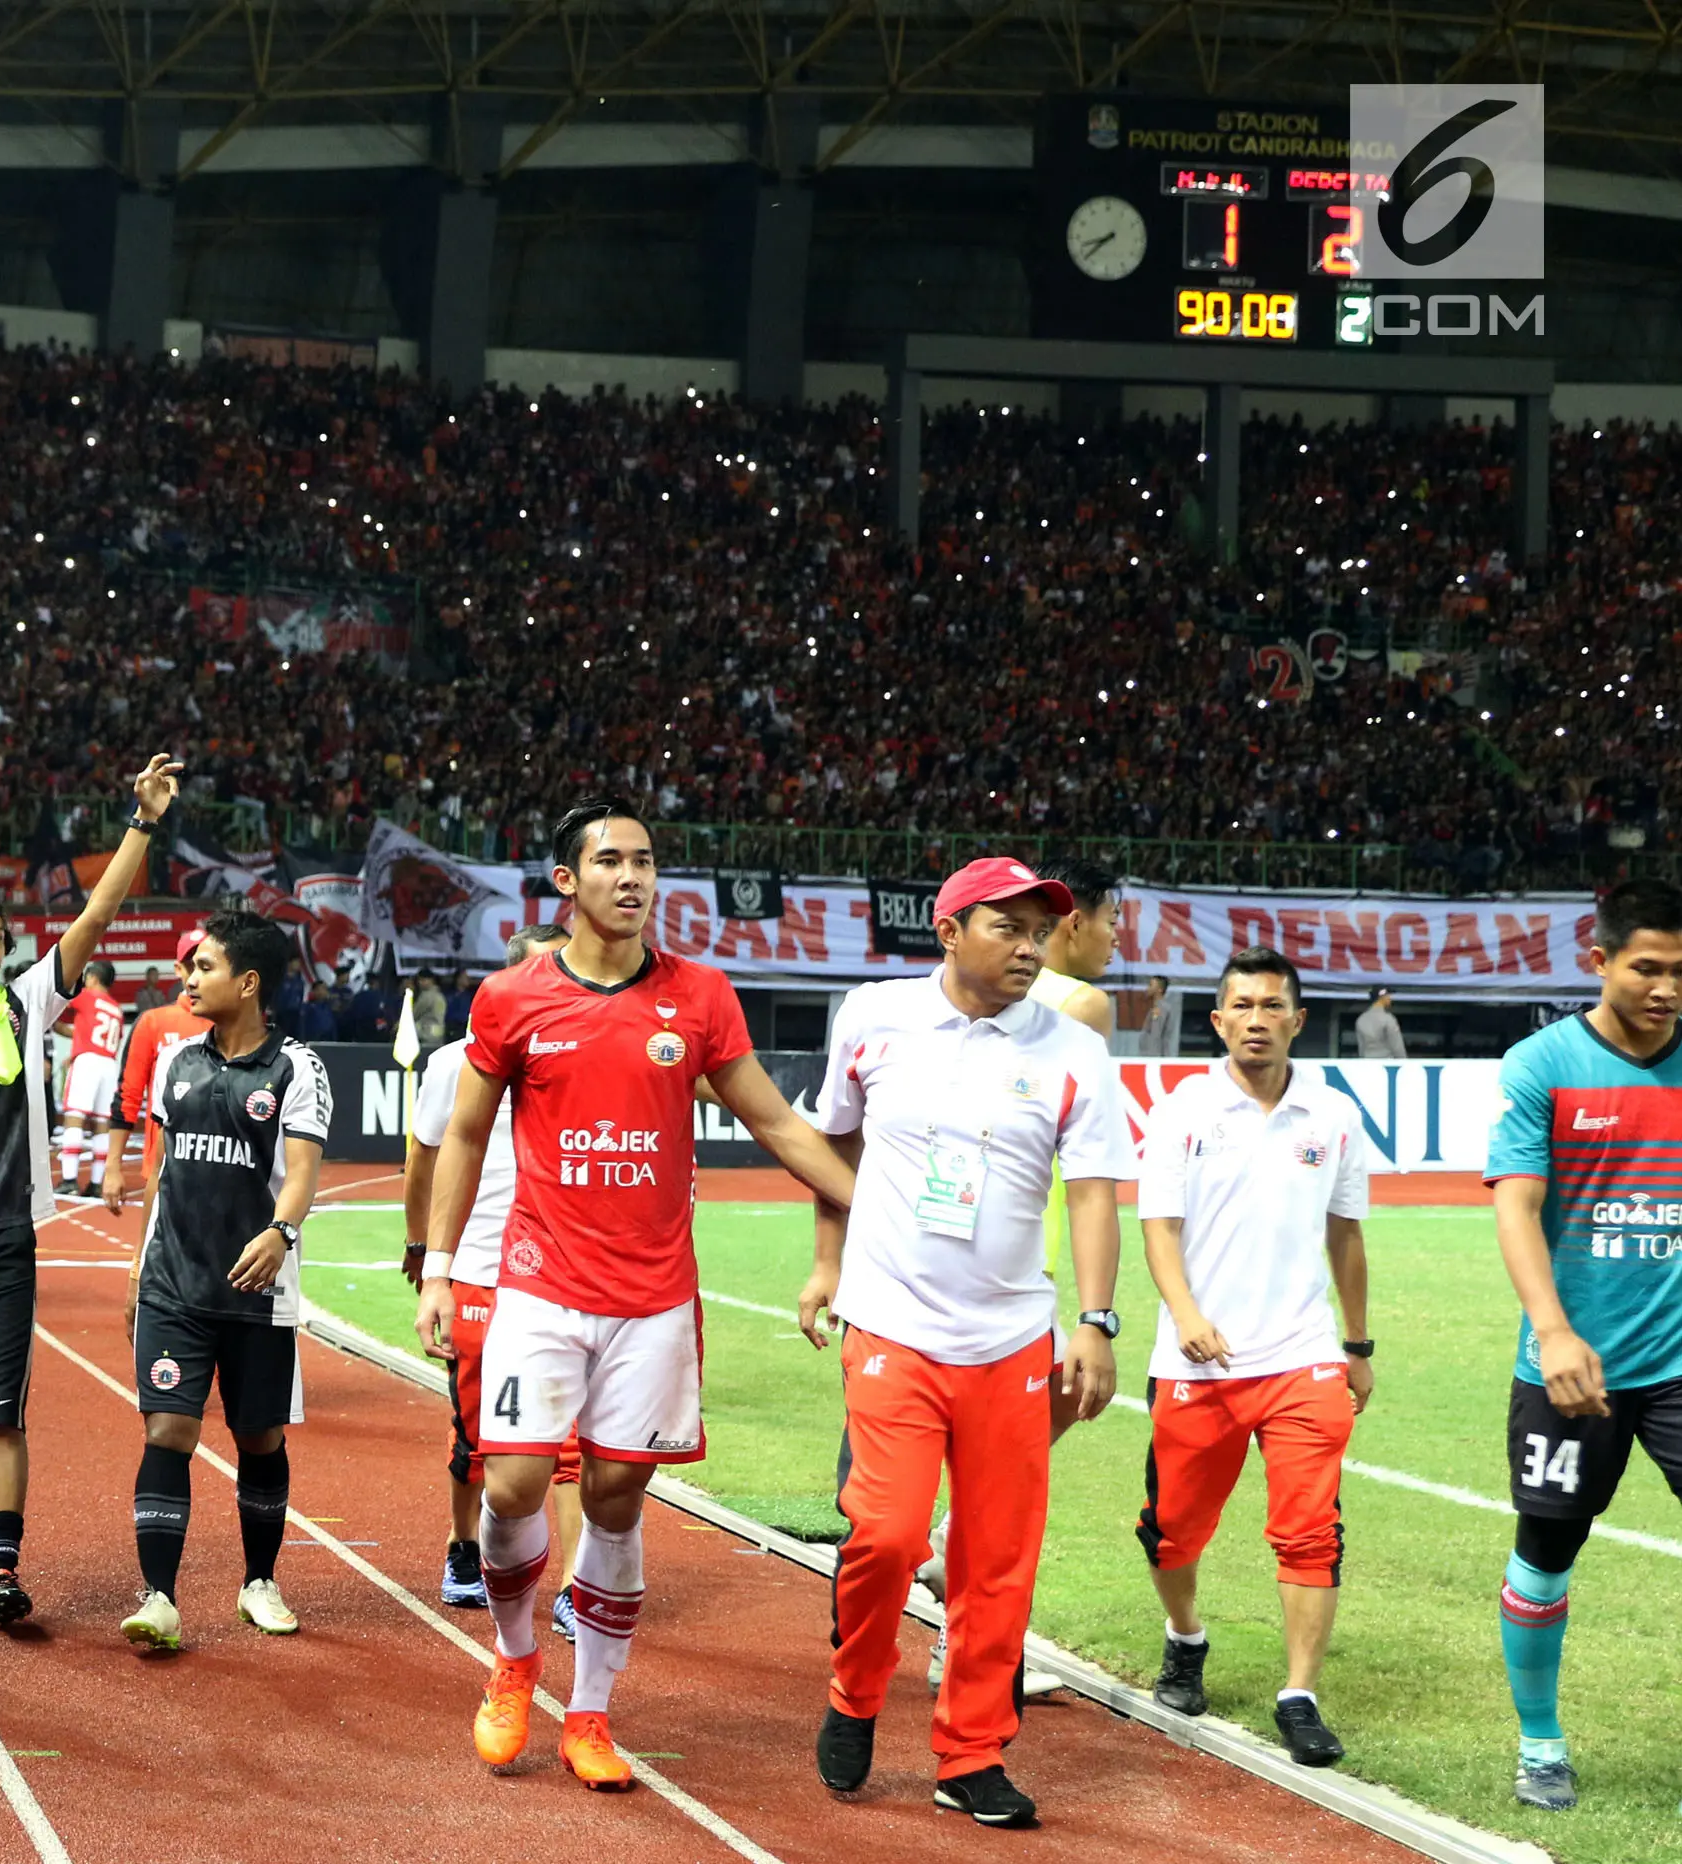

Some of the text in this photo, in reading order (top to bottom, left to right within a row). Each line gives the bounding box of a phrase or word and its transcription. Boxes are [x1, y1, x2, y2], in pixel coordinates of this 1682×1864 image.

[1128, 130, 1397, 160] PATRIOT CANDRABHAGA
[1217, 110, 1318, 133] STADION
[1225, 203, 1239, 267] 1
[1322, 205, 1363, 275] 2
[1227, 905, 1553, 975] DENGAN
[173, 1132, 256, 1169] OFFICIAL
[597, 1161, 657, 1187] TOA
[494, 1375, 522, 1426] 4
[1521, 1432, 1581, 1494] 34
